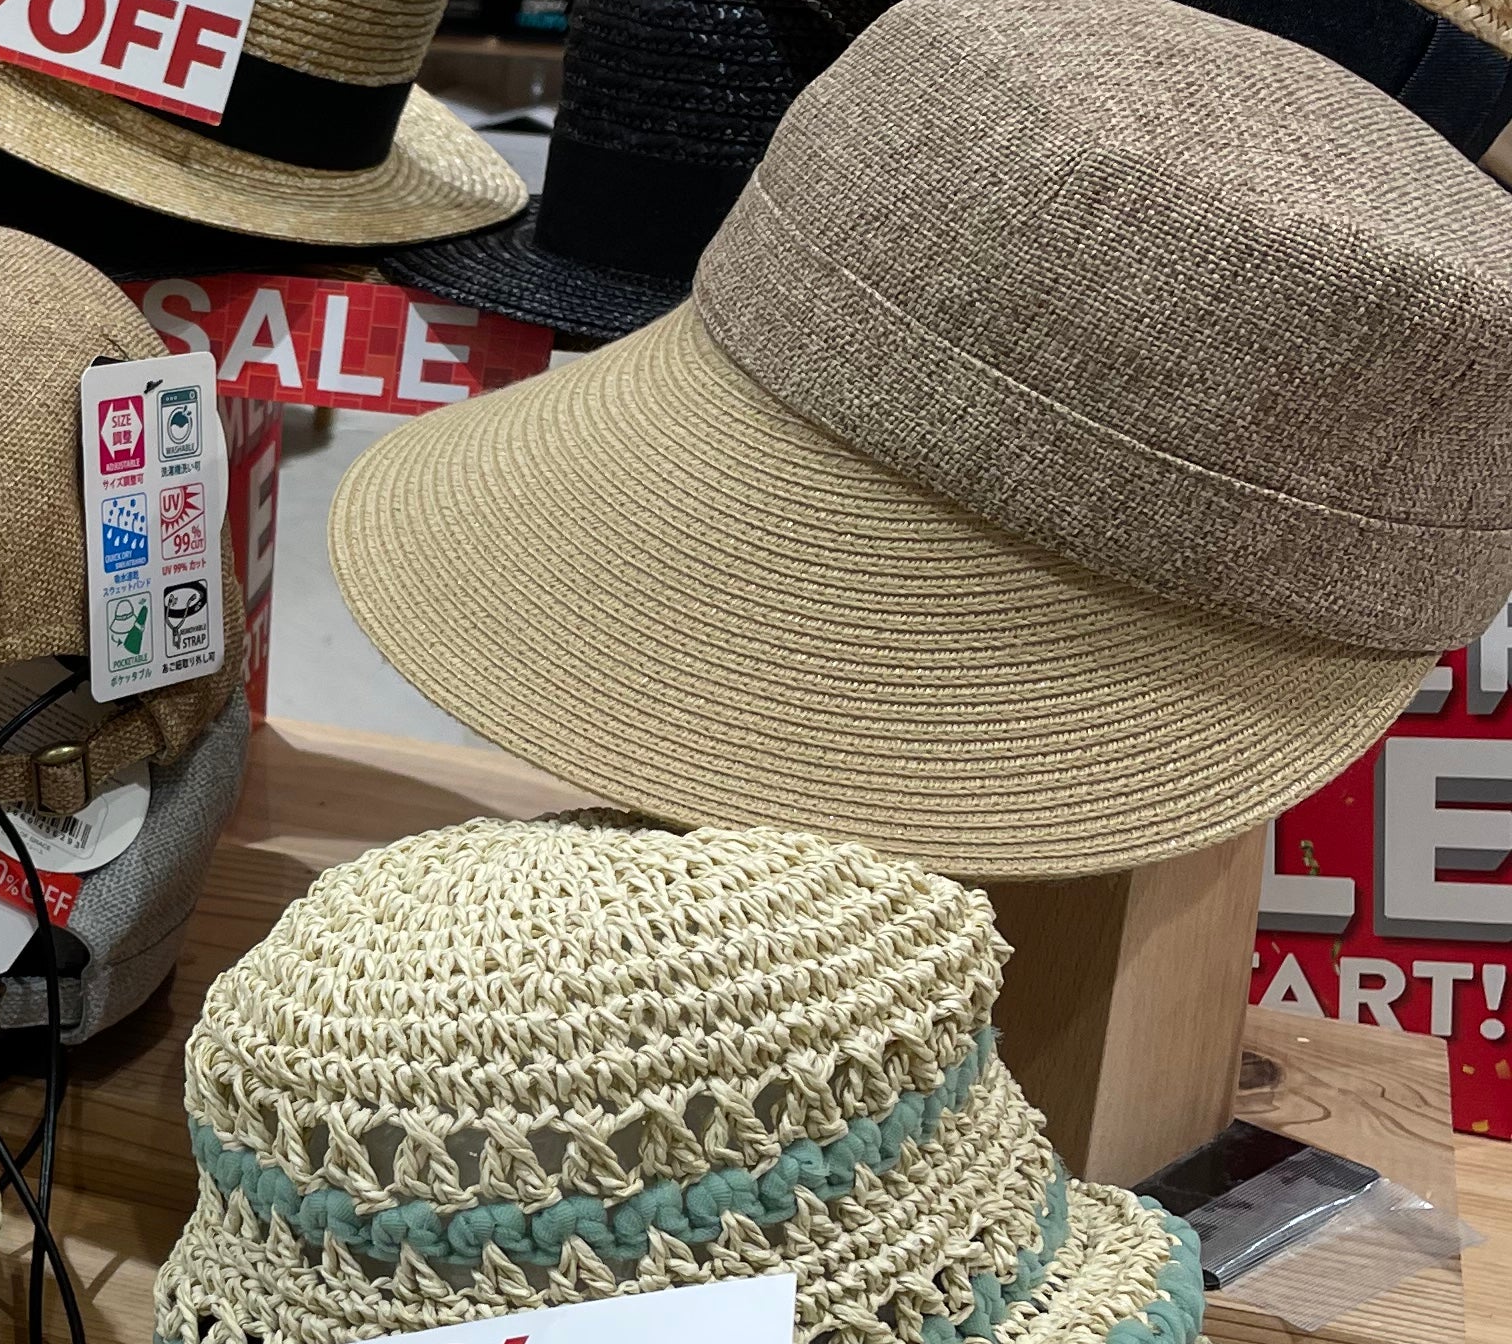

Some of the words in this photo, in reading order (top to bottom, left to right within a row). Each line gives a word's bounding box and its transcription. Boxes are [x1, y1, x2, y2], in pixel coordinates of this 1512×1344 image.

[143, 278, 478, 402] SALE
[112, 413, 132, 429] SIZE
[165, 443, 195, 455] WASHABLE
[162, 493, 180, 512] UV
[191, 539, 204, 550] CUT
[161, 566, 173, 576] UV
[173, 563, 188, 575] 99%
[189, 558, 207, 571] カット
[103, 578, 151, 597] スウェットバンド
[182, 634, 207, 649] STRAP
[113, 653, 148, 669] POCKETABLE
[111, 668, 152, 687] ポケッタブル
[1251, 953, 1507, 1040] ART!
